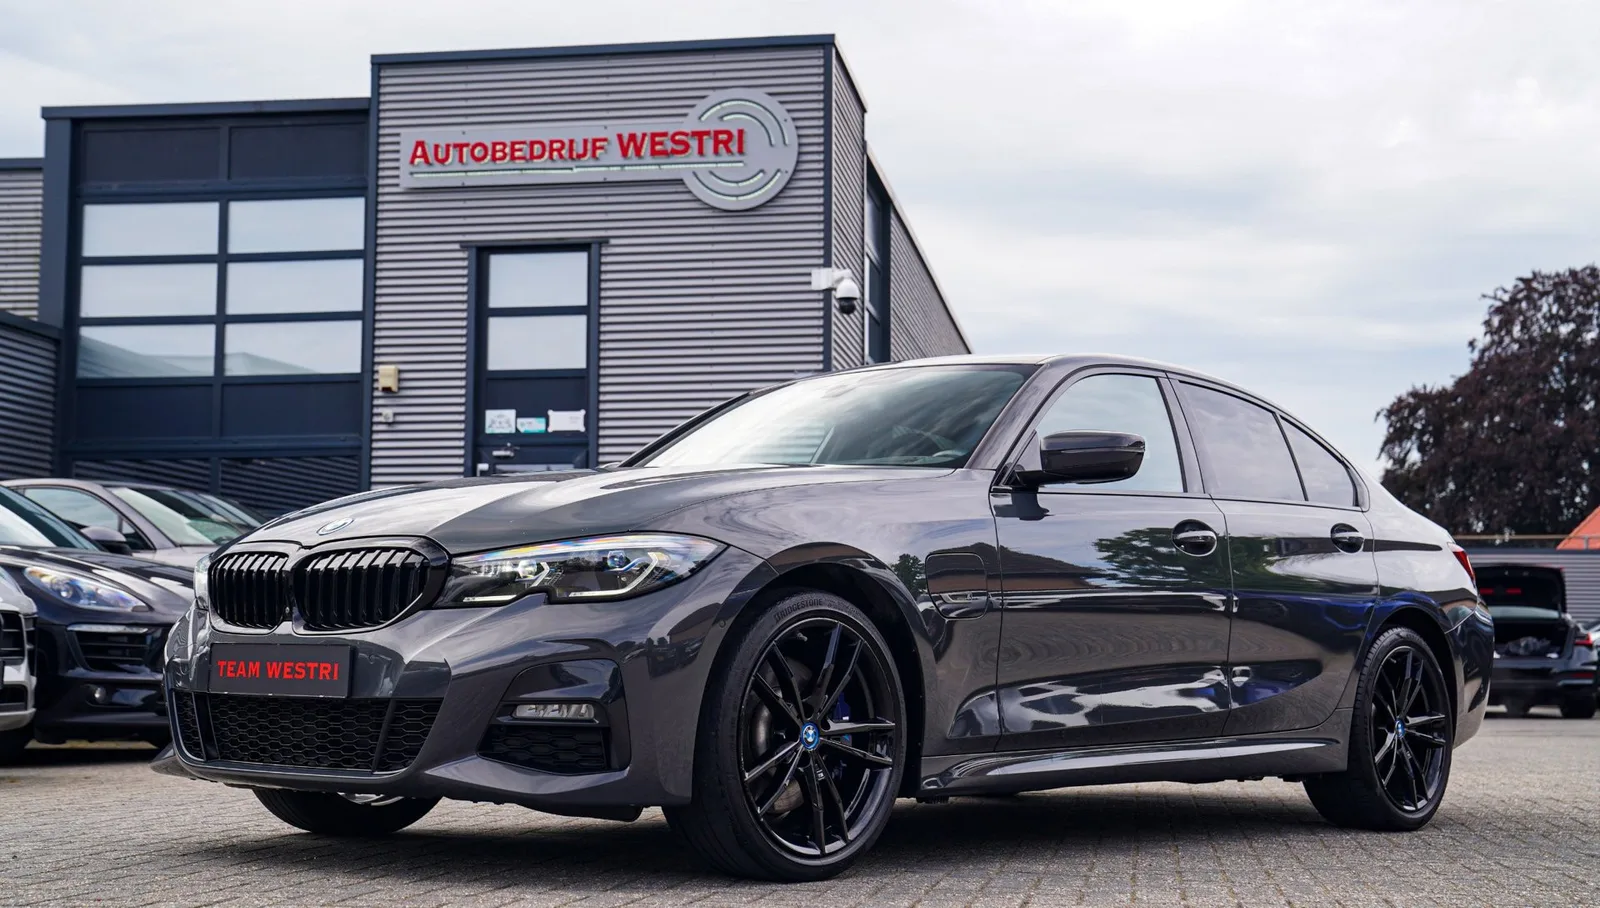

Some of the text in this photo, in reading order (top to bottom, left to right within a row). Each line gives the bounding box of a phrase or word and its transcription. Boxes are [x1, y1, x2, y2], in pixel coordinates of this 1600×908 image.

[409, 128, 745, 165] AUTOBEDRIJF WESTRI
[774, 599, 822, 623] BRIDGESTONE
[216, 659, 340, 681] TEAM WESTRI
